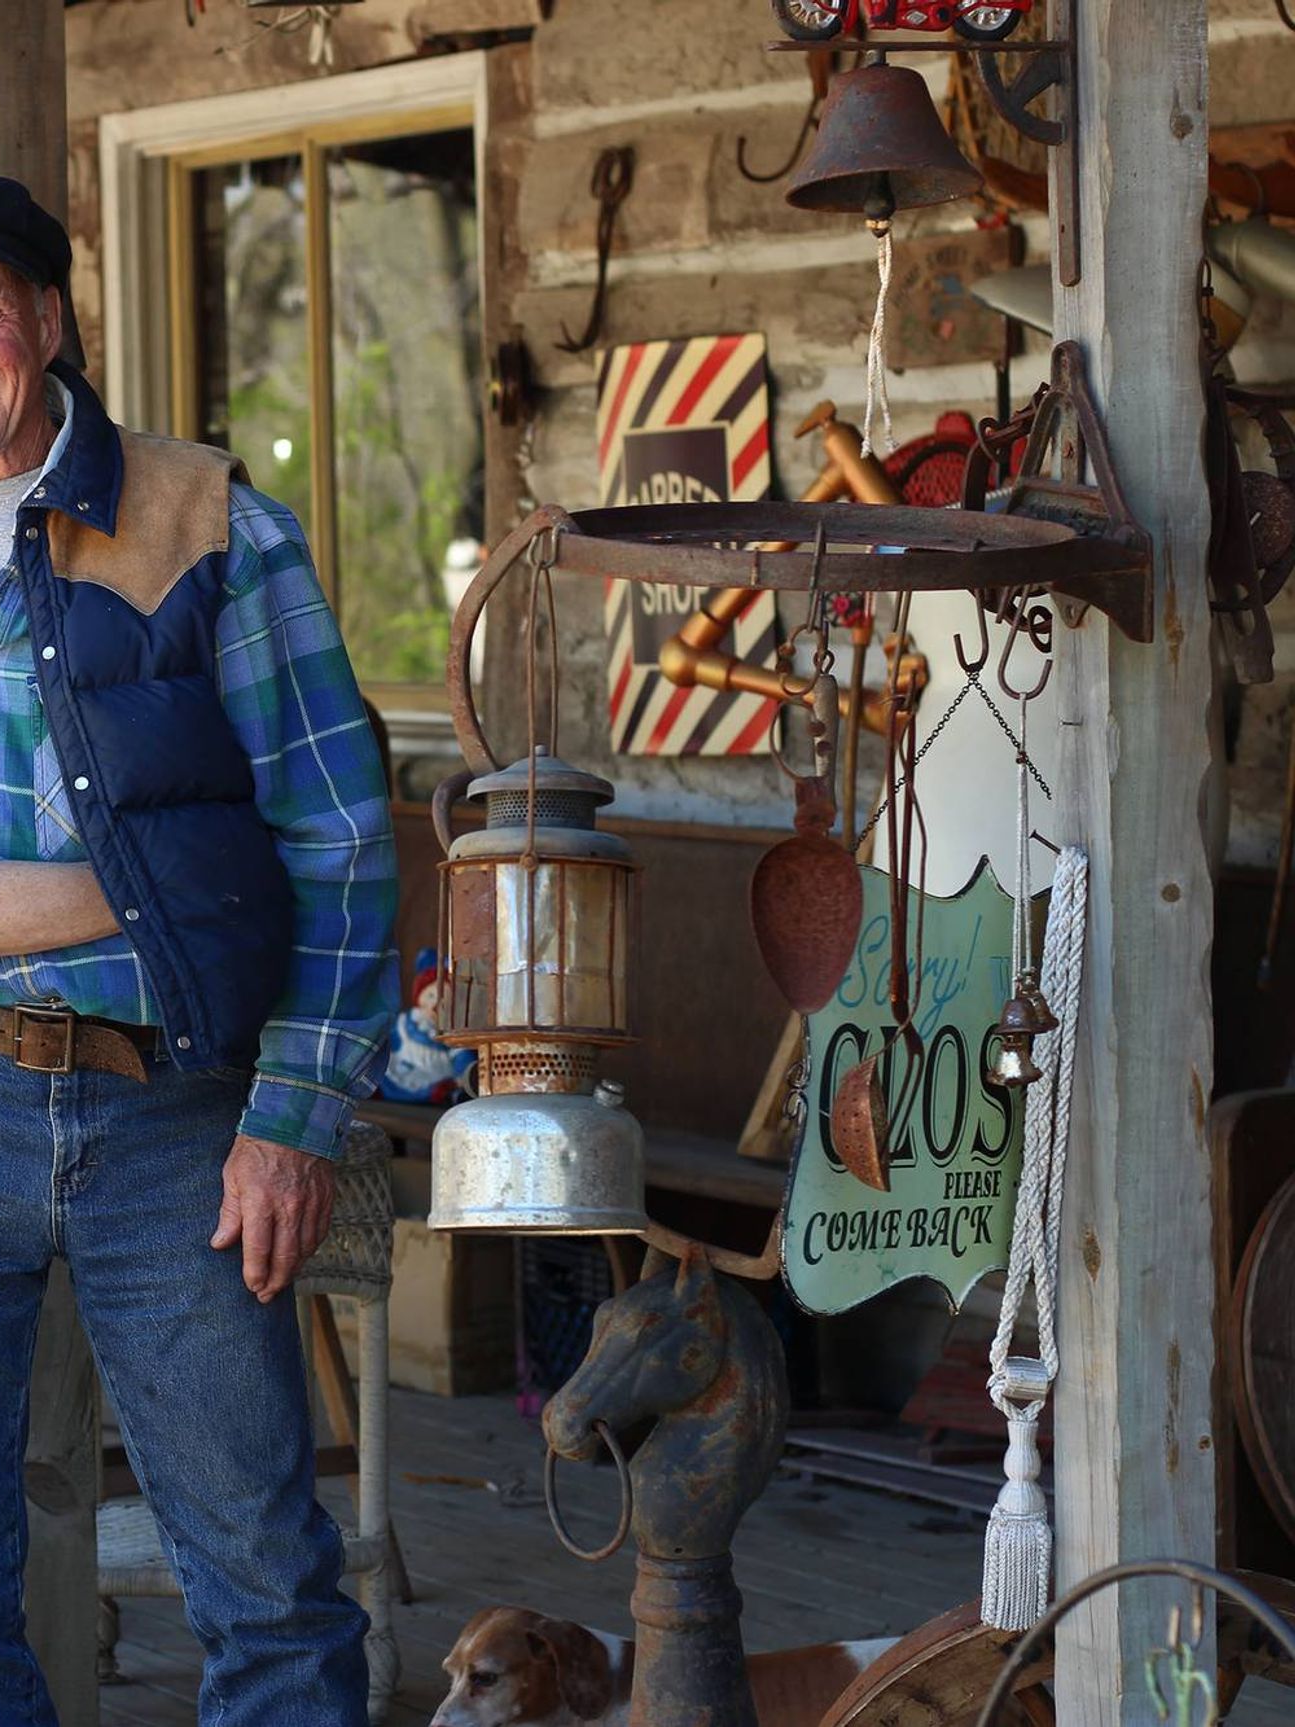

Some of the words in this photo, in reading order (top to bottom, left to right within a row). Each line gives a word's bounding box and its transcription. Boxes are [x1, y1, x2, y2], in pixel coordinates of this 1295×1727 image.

[837, 915, 982, 1040] Sory!
[819, 1023, 1015, 1173] CLOS
[944, 1170, 1002, 1199] PLEASE
[803, 1209, 902, 1265] COME
[907, 1205, 993, 1258] BACK
